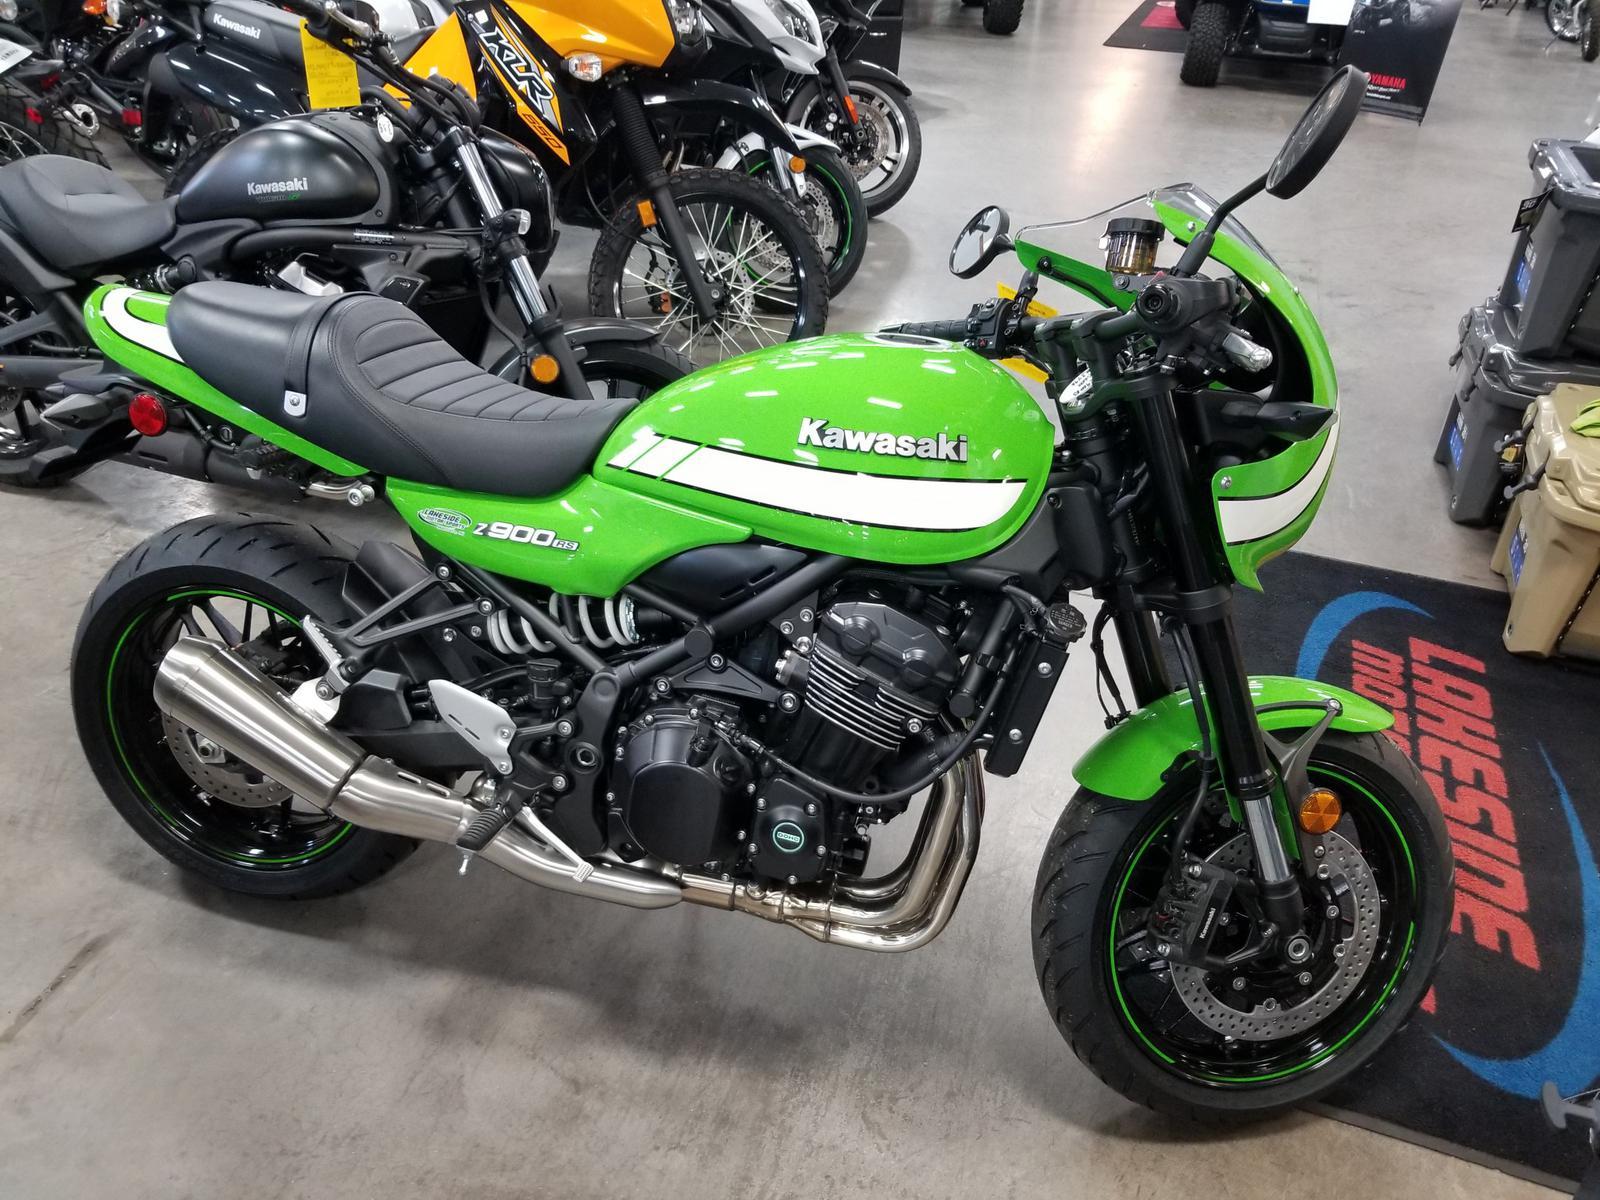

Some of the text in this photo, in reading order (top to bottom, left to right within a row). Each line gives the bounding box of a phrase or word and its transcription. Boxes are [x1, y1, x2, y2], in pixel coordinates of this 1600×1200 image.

[212, 12, 262, 40] Kawasaki
[478, 25, 554, 114] KLR
[1371, 73, 1407, 89] YAMAHA
[521, 112, 563, 149] 650
[247, 177, 309, 196] Kawasaki
[797, 416, 968, 463] Kawasaki
[1409, 636, 1541, 972] LAKESIDE
[777, 832, 800, 843] DOHC
[1199, 907, 1217, 939] Kawasaki
